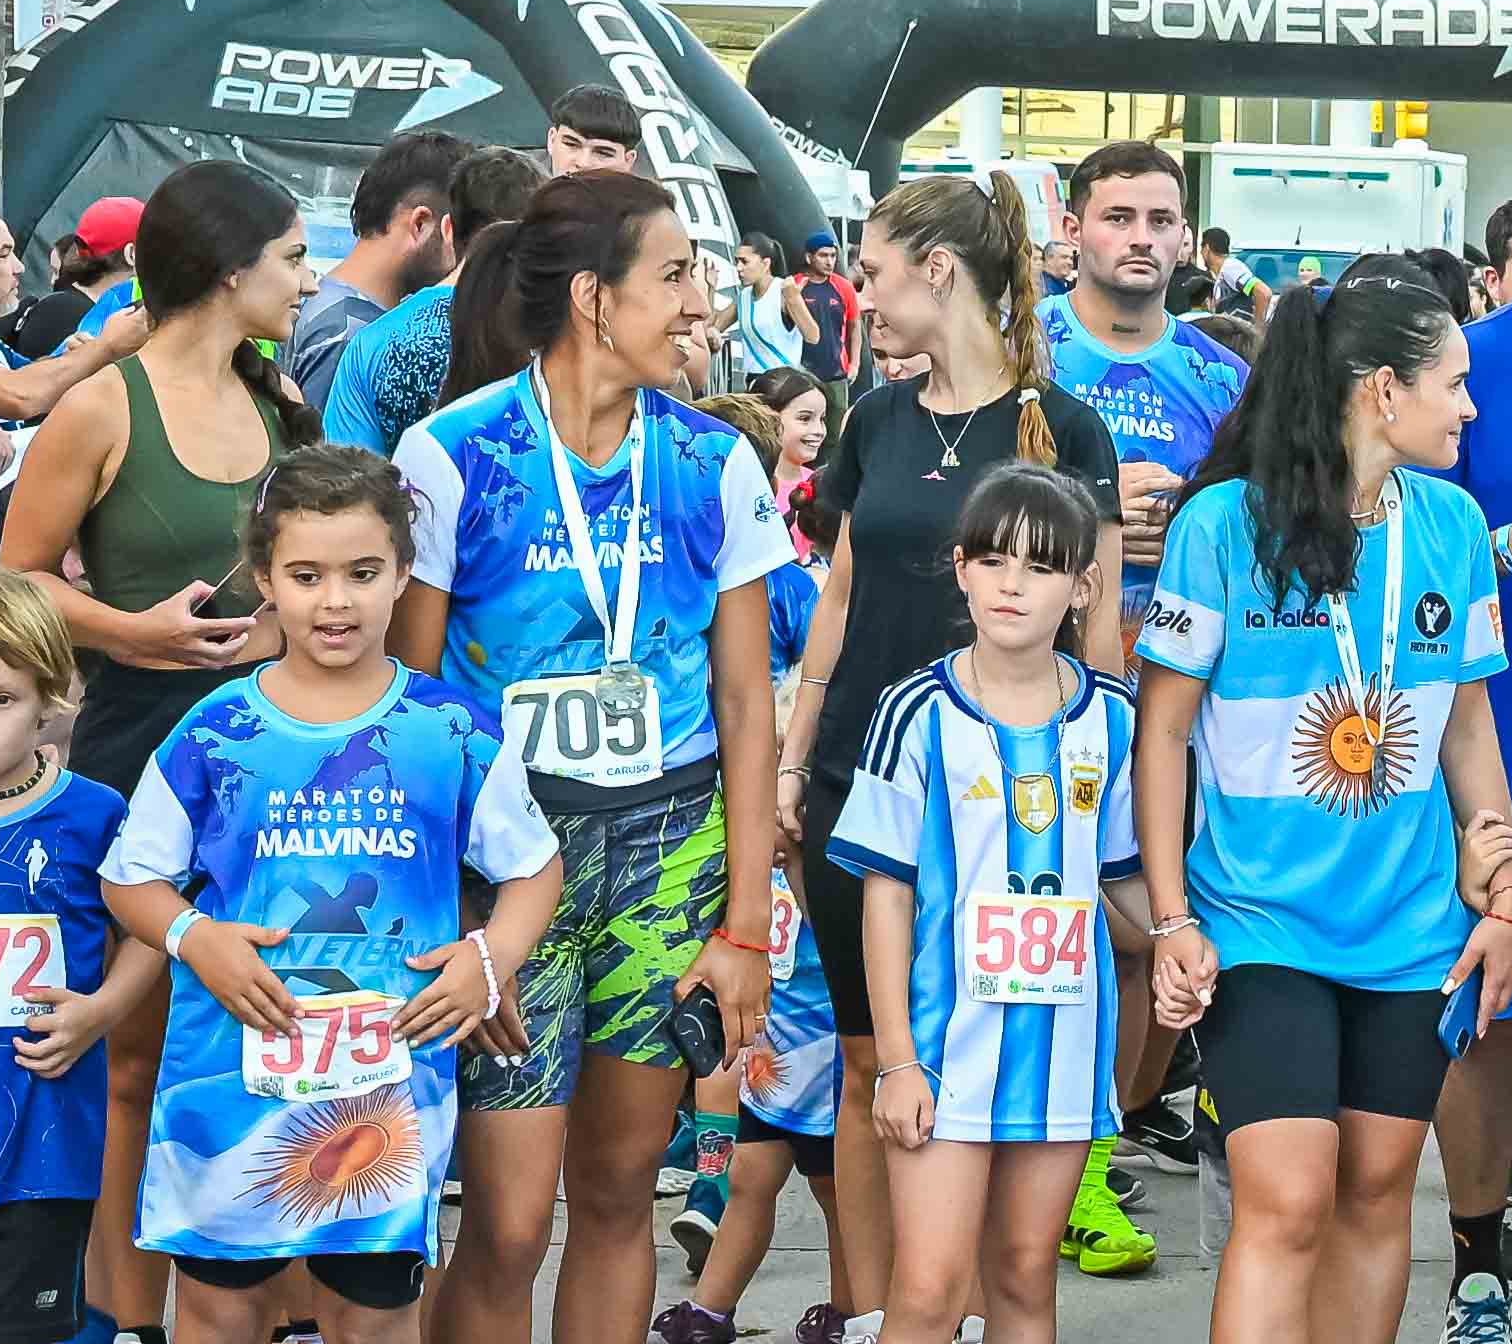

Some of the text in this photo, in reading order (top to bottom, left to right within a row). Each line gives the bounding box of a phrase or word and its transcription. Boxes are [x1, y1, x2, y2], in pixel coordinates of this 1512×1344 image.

[222, 42, 472, 89] POWER
[210, 77, 356, 120] ADE
[1106, 412, 1175, 442] VINAS
[511, 689, 646, 763] 705
[268, 786, 405, 805] MARATÓN
[268, 807, 403, 823] HÉROES DE
[256, 827, 417, 859] MALVINAS
[975, 905, 1088, 977] 584
[261, 1001, 391, 1074] 575
